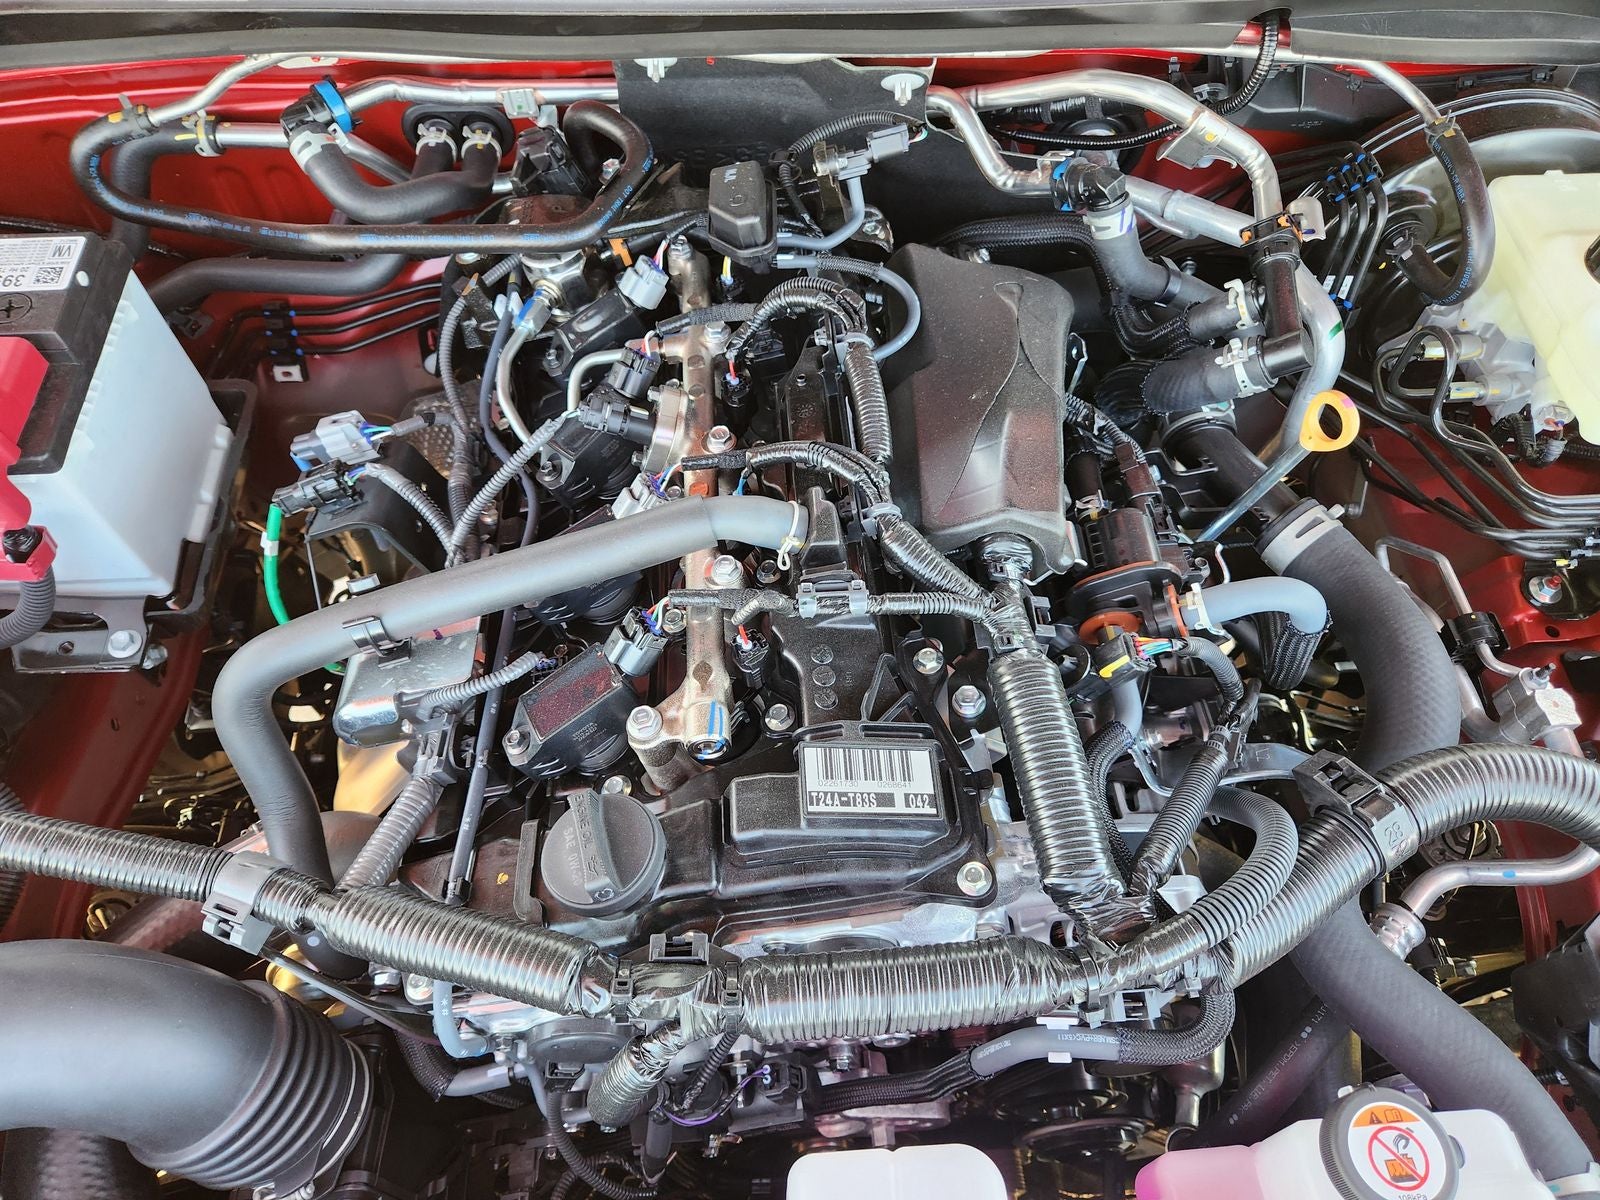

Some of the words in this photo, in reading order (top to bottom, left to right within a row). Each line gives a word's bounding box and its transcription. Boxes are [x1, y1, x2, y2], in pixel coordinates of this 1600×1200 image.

[51, 245, 72, 257] VM
[811, 791, 877, 808] T24A-T83S
[909, 794, 930, 809] 042
[573, 793, 591, 830] ENGINE
[563, 827, 576, 849] SAE
[581, 832, 595, 849] OIL
